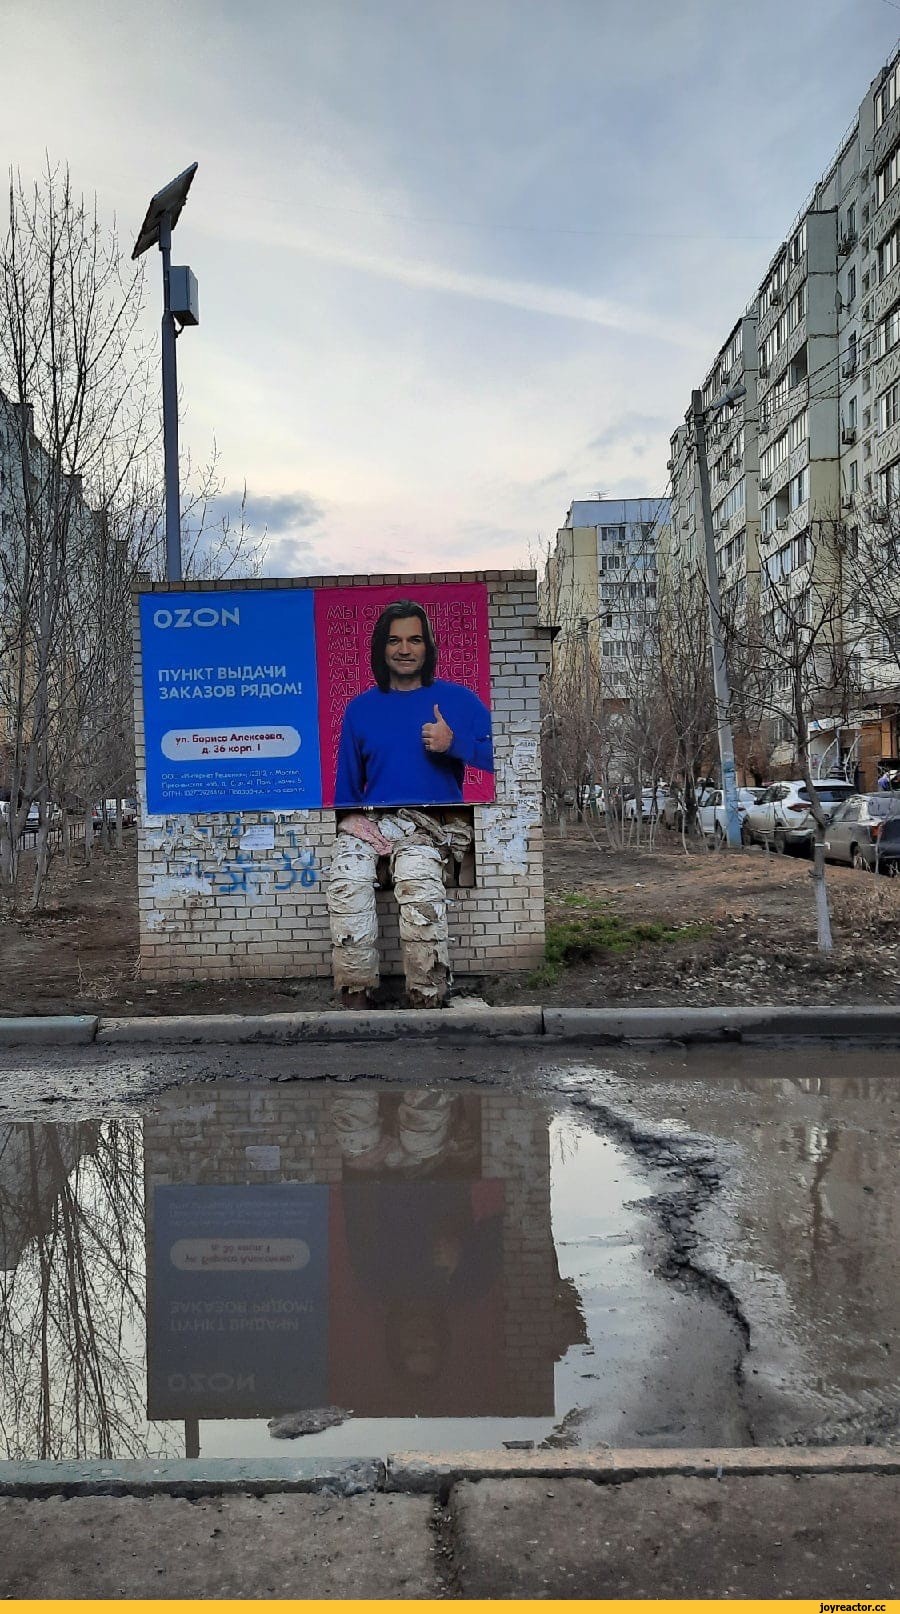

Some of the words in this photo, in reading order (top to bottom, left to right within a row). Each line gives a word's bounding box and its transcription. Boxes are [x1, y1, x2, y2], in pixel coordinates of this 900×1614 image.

[153, 607, 240, 629] OZON
[158, 667, 214, 682] ПУНКТ
[217, 665, 287, 681] ВЫДАЧИ
[159, 685, 236, 700] ЗАКАЗОВ
[241, 682, 302, 699] РЯДОМ!
[175, 736, 190, 746] ул.
[192, 734, 228, 744] Бориса
[230, 732, 285, 743] Алексеева,
[201, 746, 211, 755] д.
[213, 745, 226, 753] 36
[228, 745, 255, 755] корп.
